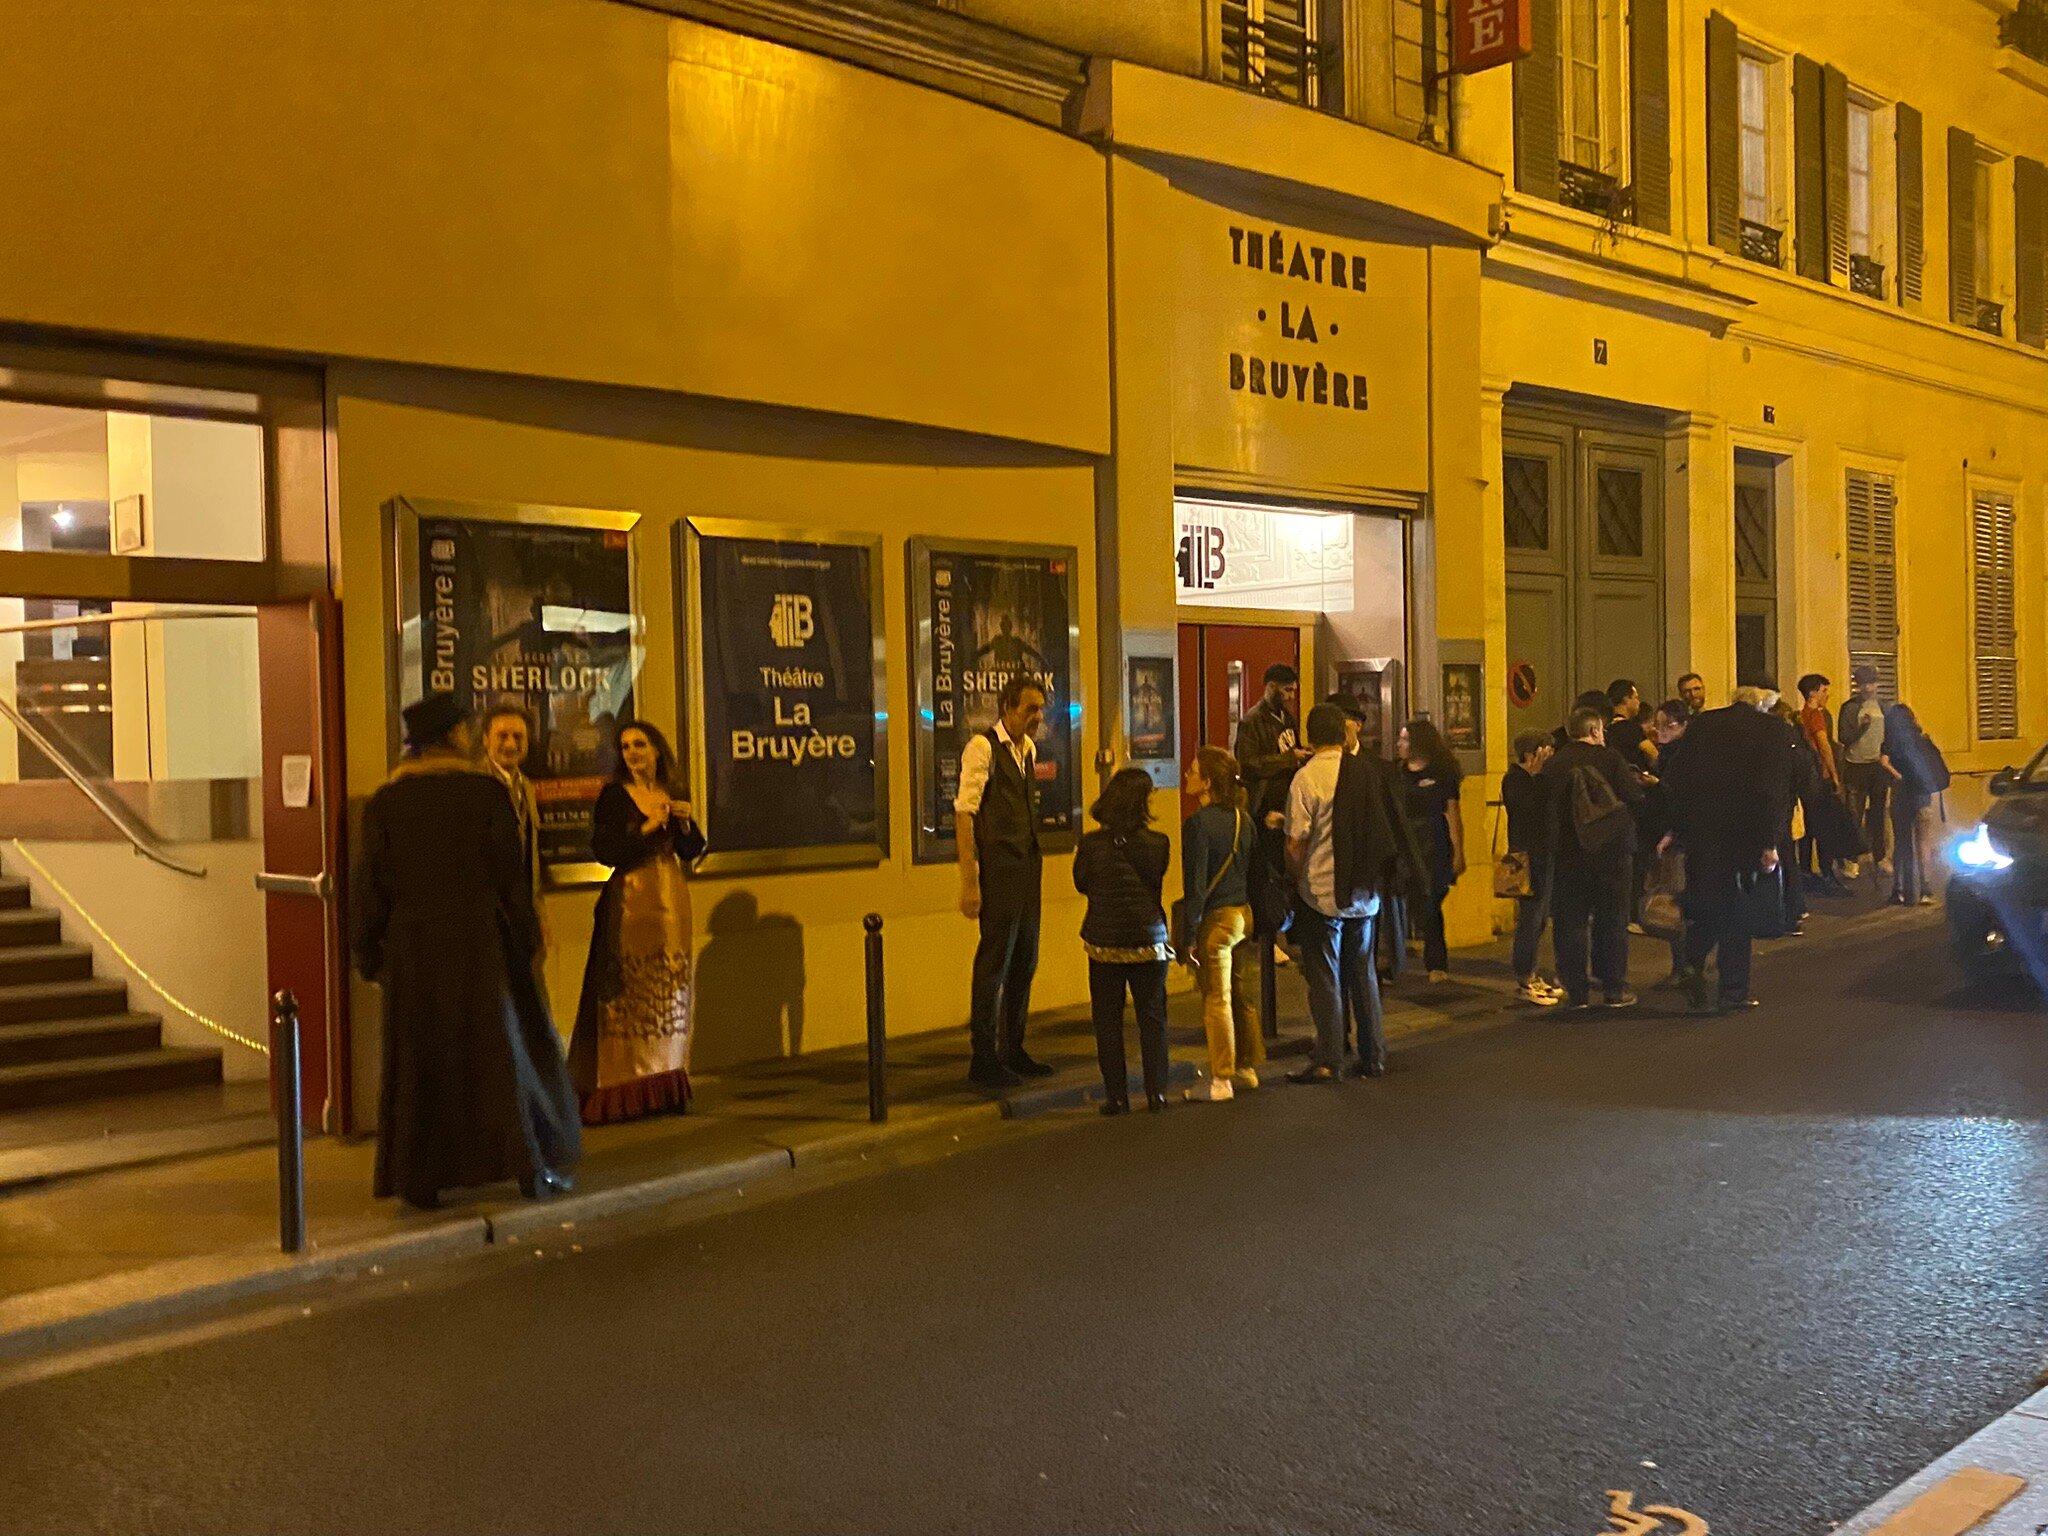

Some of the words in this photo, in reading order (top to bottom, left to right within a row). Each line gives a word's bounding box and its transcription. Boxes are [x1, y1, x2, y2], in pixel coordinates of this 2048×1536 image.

[1228, 226, 1368, 293] THÉATRE
[1228, 352, 1369, 411] BRUYÈRE
[430, 575, 460, 692] Bruyère
[934, 598, 955, 692] Bruyère
[472, 665, 612, 692] SHERLOCK
[760, 666, 825, 689] Théâtre
[773, 696, 811, 729] La
[936, 700, 955, 728] La
[731, 727, 857, 768] Bruyère
